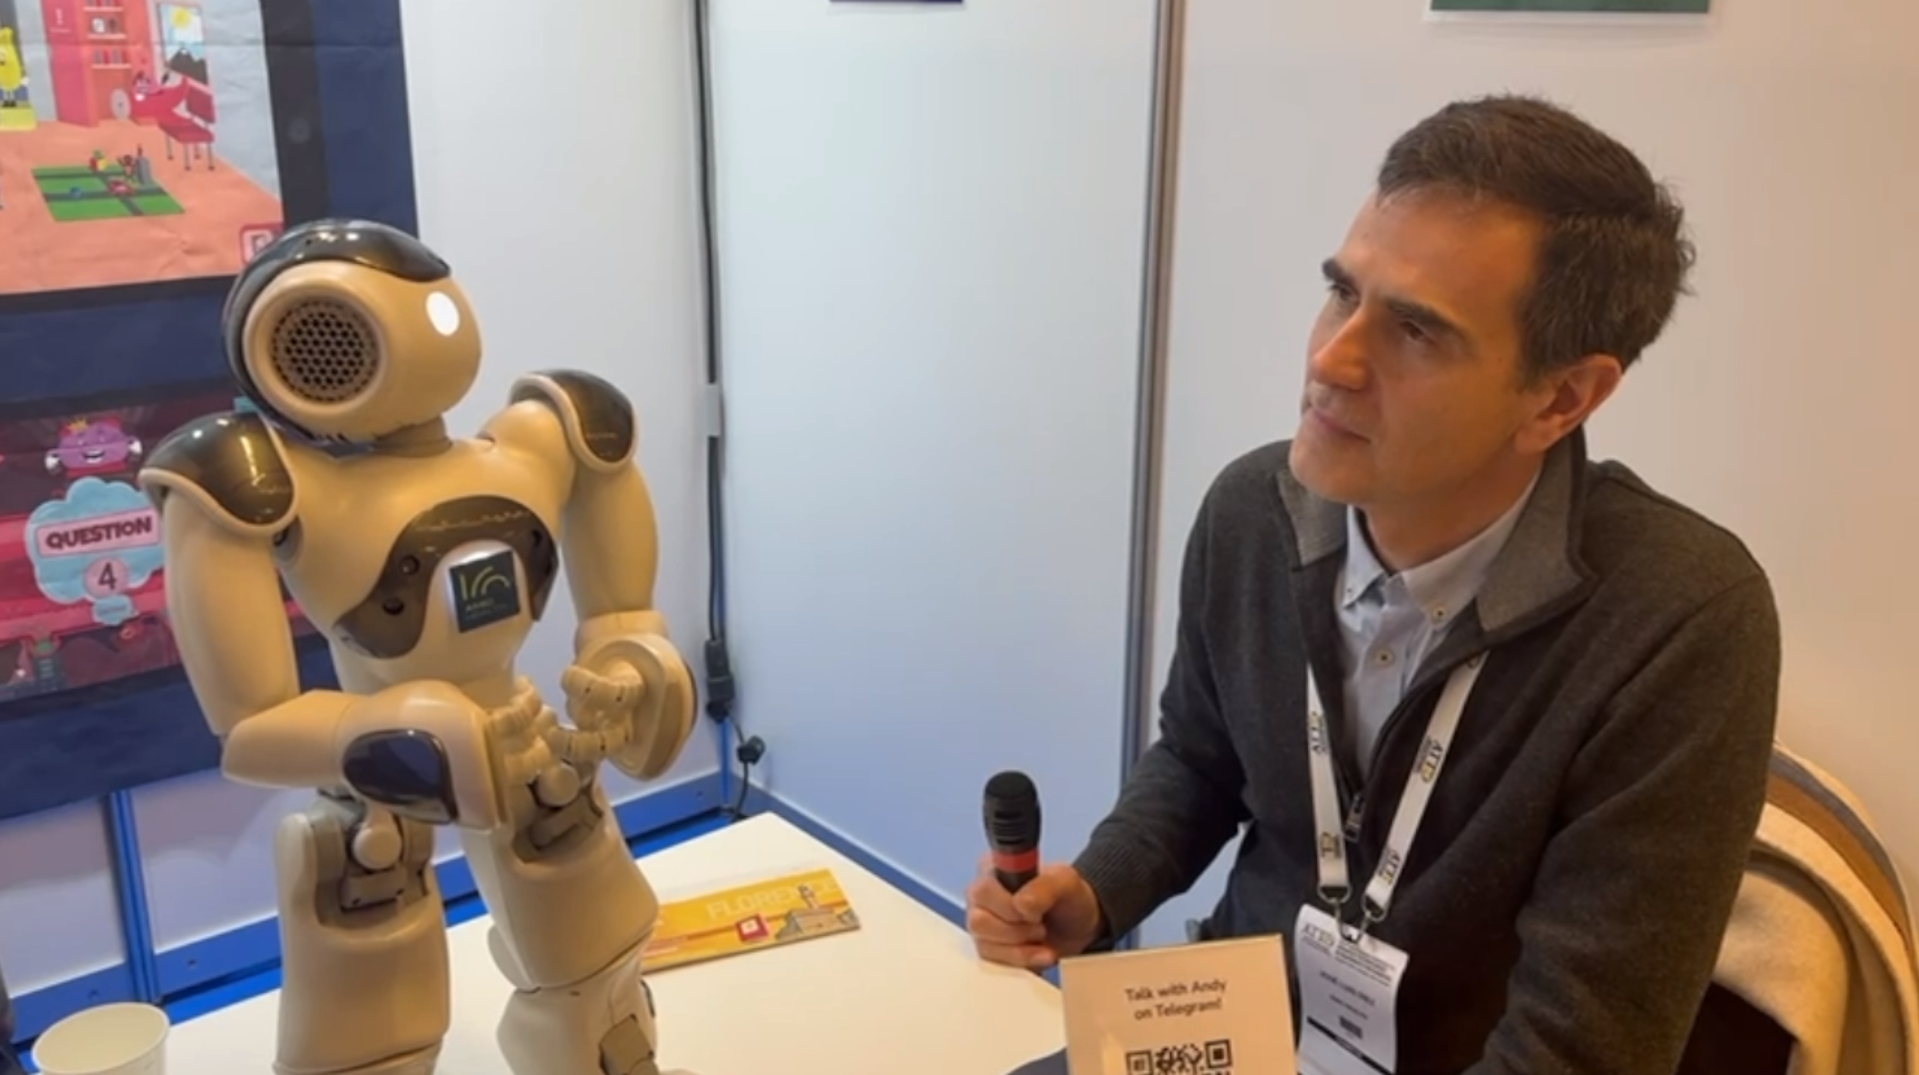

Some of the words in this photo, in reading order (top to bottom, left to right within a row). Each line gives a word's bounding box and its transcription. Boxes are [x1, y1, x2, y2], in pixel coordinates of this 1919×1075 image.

[46, 516, 152, 550] QUESTION
[97, 562, 117, 590] 4
[1124, 986, 1153, 1001] Talk
[1158, 983, 1188, 997] with
[1191, 979, 1227, 994] Andy
[1134, 1009, 1153, 1020] on
[1155, 997, 1222, 1017] Telegram!
